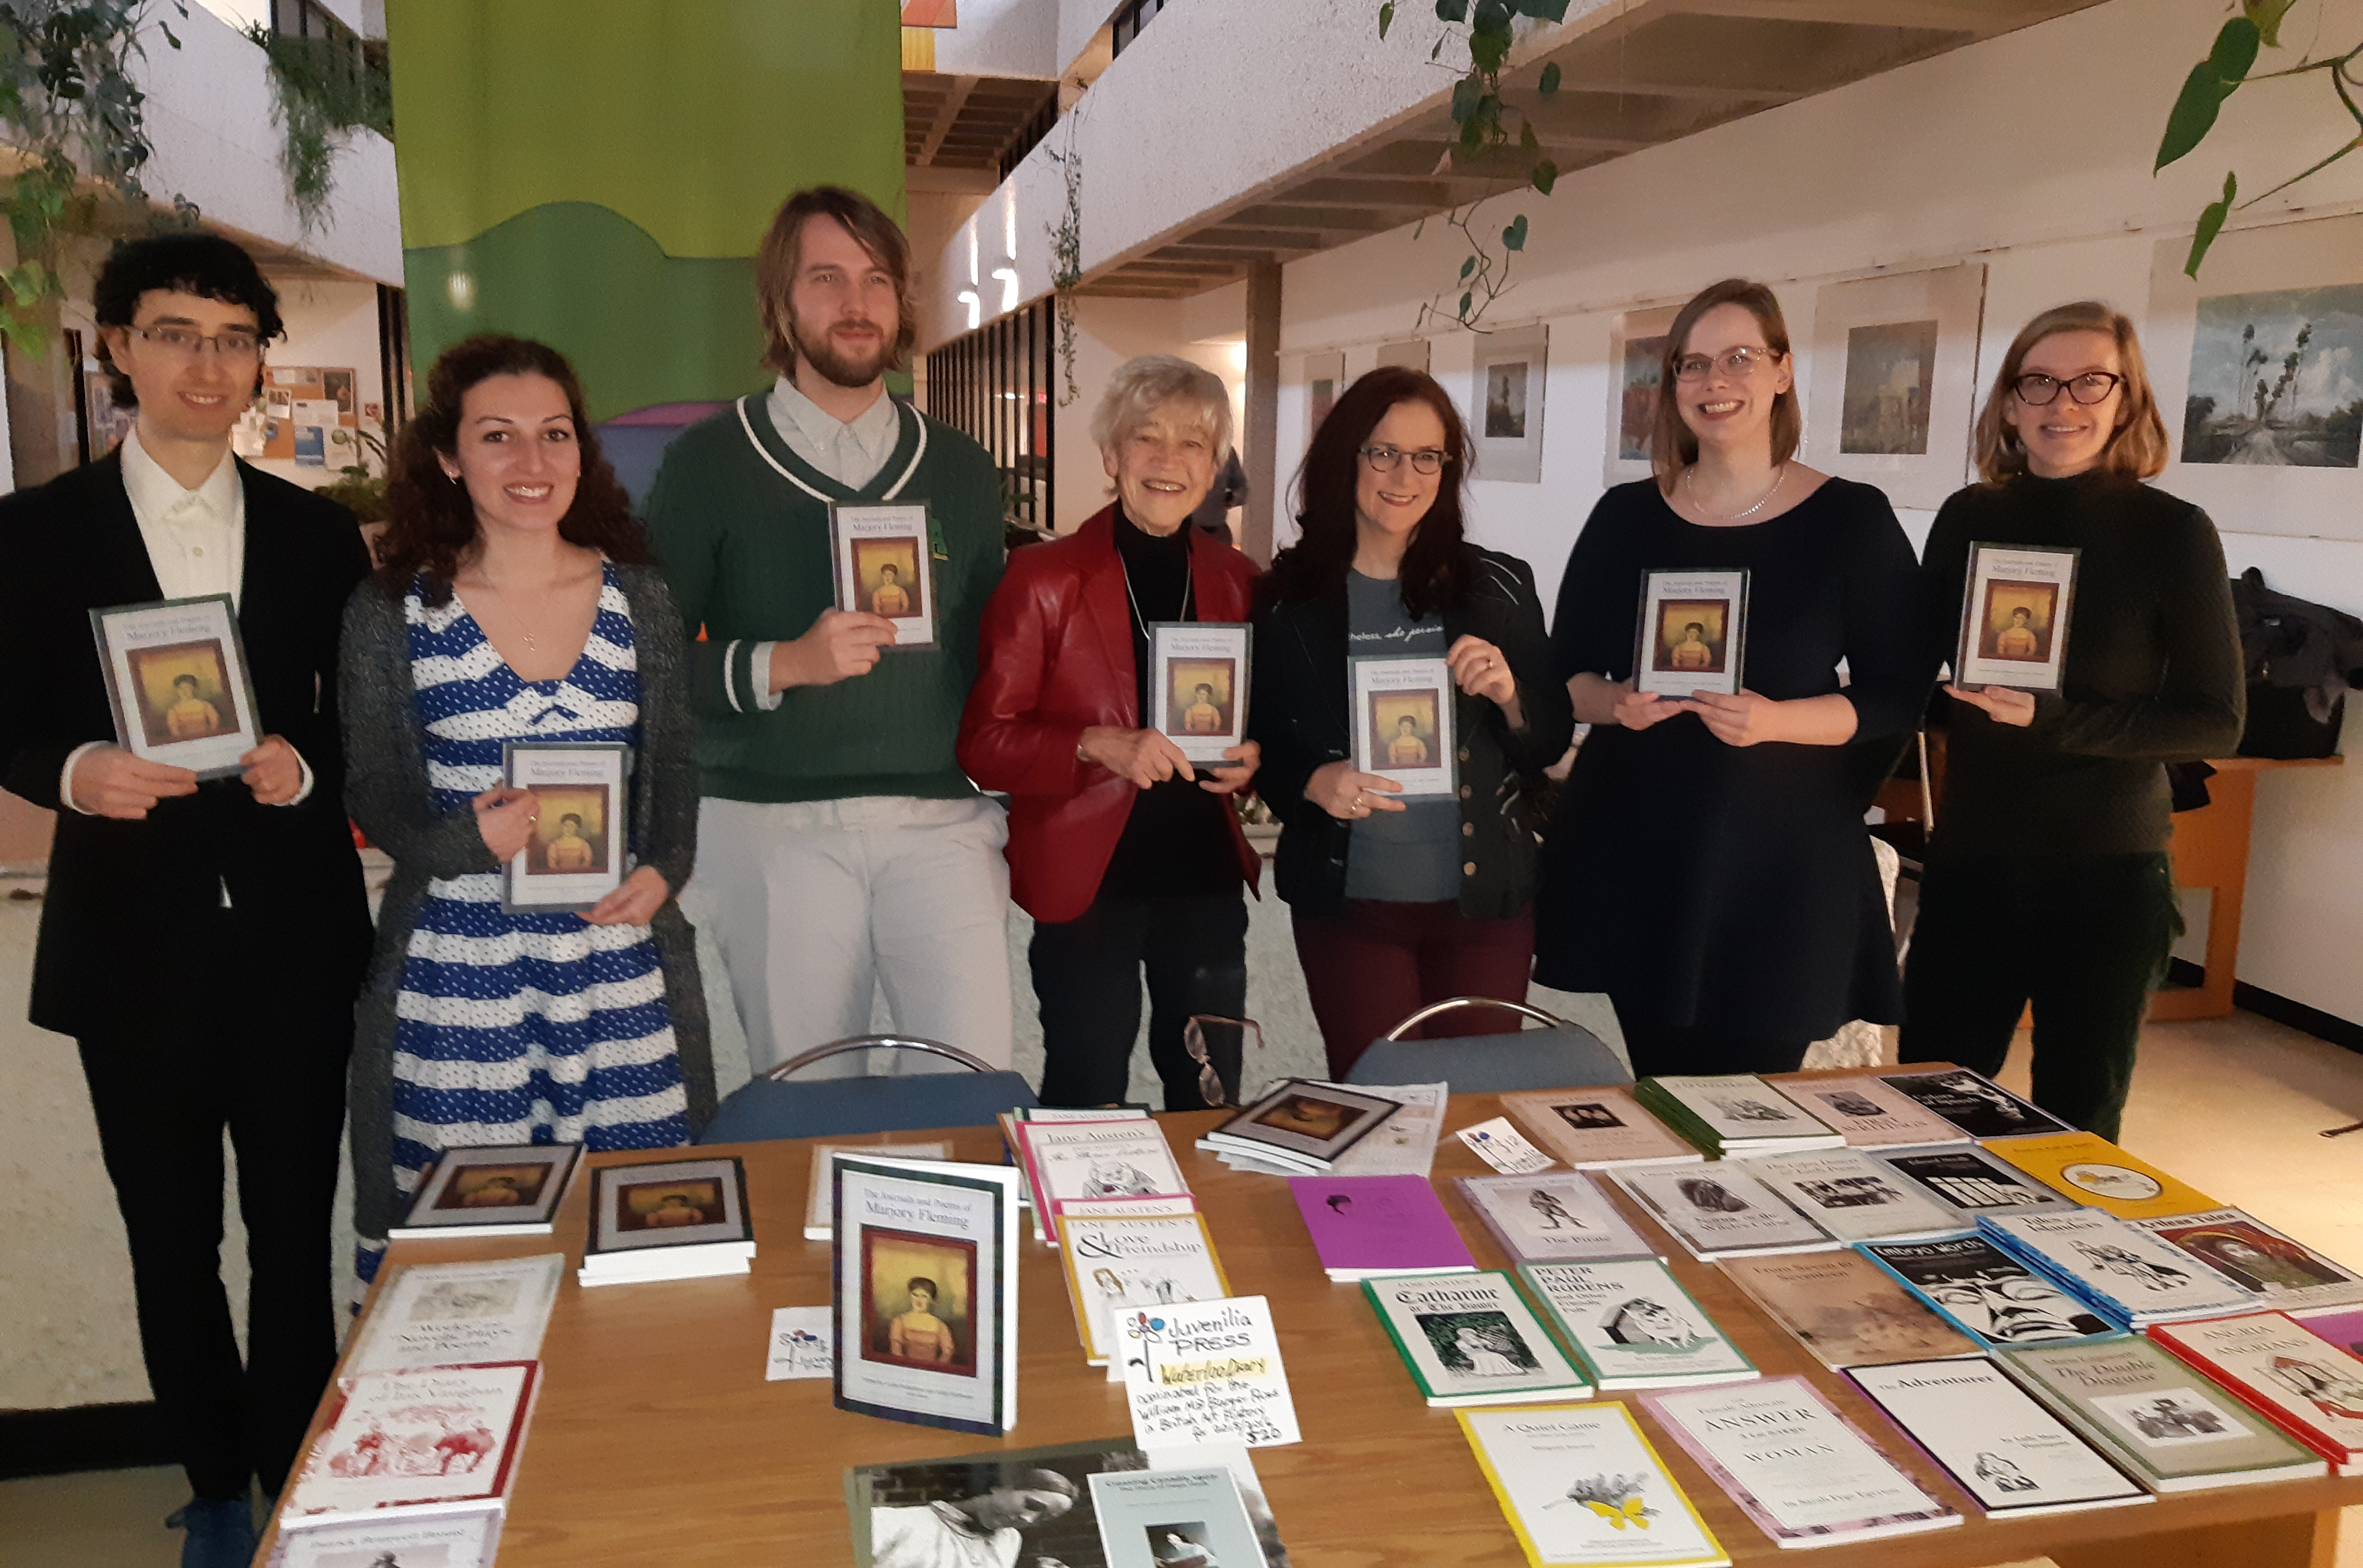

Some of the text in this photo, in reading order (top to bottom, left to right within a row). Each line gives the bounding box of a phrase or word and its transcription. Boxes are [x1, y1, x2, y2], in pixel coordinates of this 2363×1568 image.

[1046, 1128, 1148, 1143] Jane Austen's
[865, 1188, 878, 1199] The
[881, 1190, 915, 1203] Journals
[915, 1197, 931, 1207] and
[933, 1198, 960, 1210] Poems
[866, 1200, 970, 1231] Marjory Fleming
[2190, 1213, 2237, 1224] Tales
[1070, 1221, 1105, 1229] JANE
[1076, 1234, 1124, 1259] &
[1098, 1231, 1149, 1250] Love
[1571, 1235, 1611, 1244] Pirate
[1873, 1246, 1935, 1259] Embryo
[1932, 1240, 1985, 1253] Words
[1534, 1266, 1594, 1276] PETER
[1792, 1262, 1835, 1271] Seven
[1540, 1275, 1588, 1284] PAUL
[1547, 1281, 1625, 1293] RUBENS
[1394, 1288, 1500, 1304] Catharine
[1167, 1306, 1253, 1338] Juvenilia
[2202, 1325, 2275, 1339] ANGRIA
[1168, 1332, 1252, 1357] PRESS
[2214, 1339, 2310, 1355] ANGRIANS
[2055, 1359, 2156, 1378] The Double
[1898, 1375, 1994, 1390] Adventurer
[2078, 1374, 2155, 1387] Disguise
[1503, 1422, 1601, 1434] A Quiet Game
[1704, 1408, 1817, 1433] ANSWER
